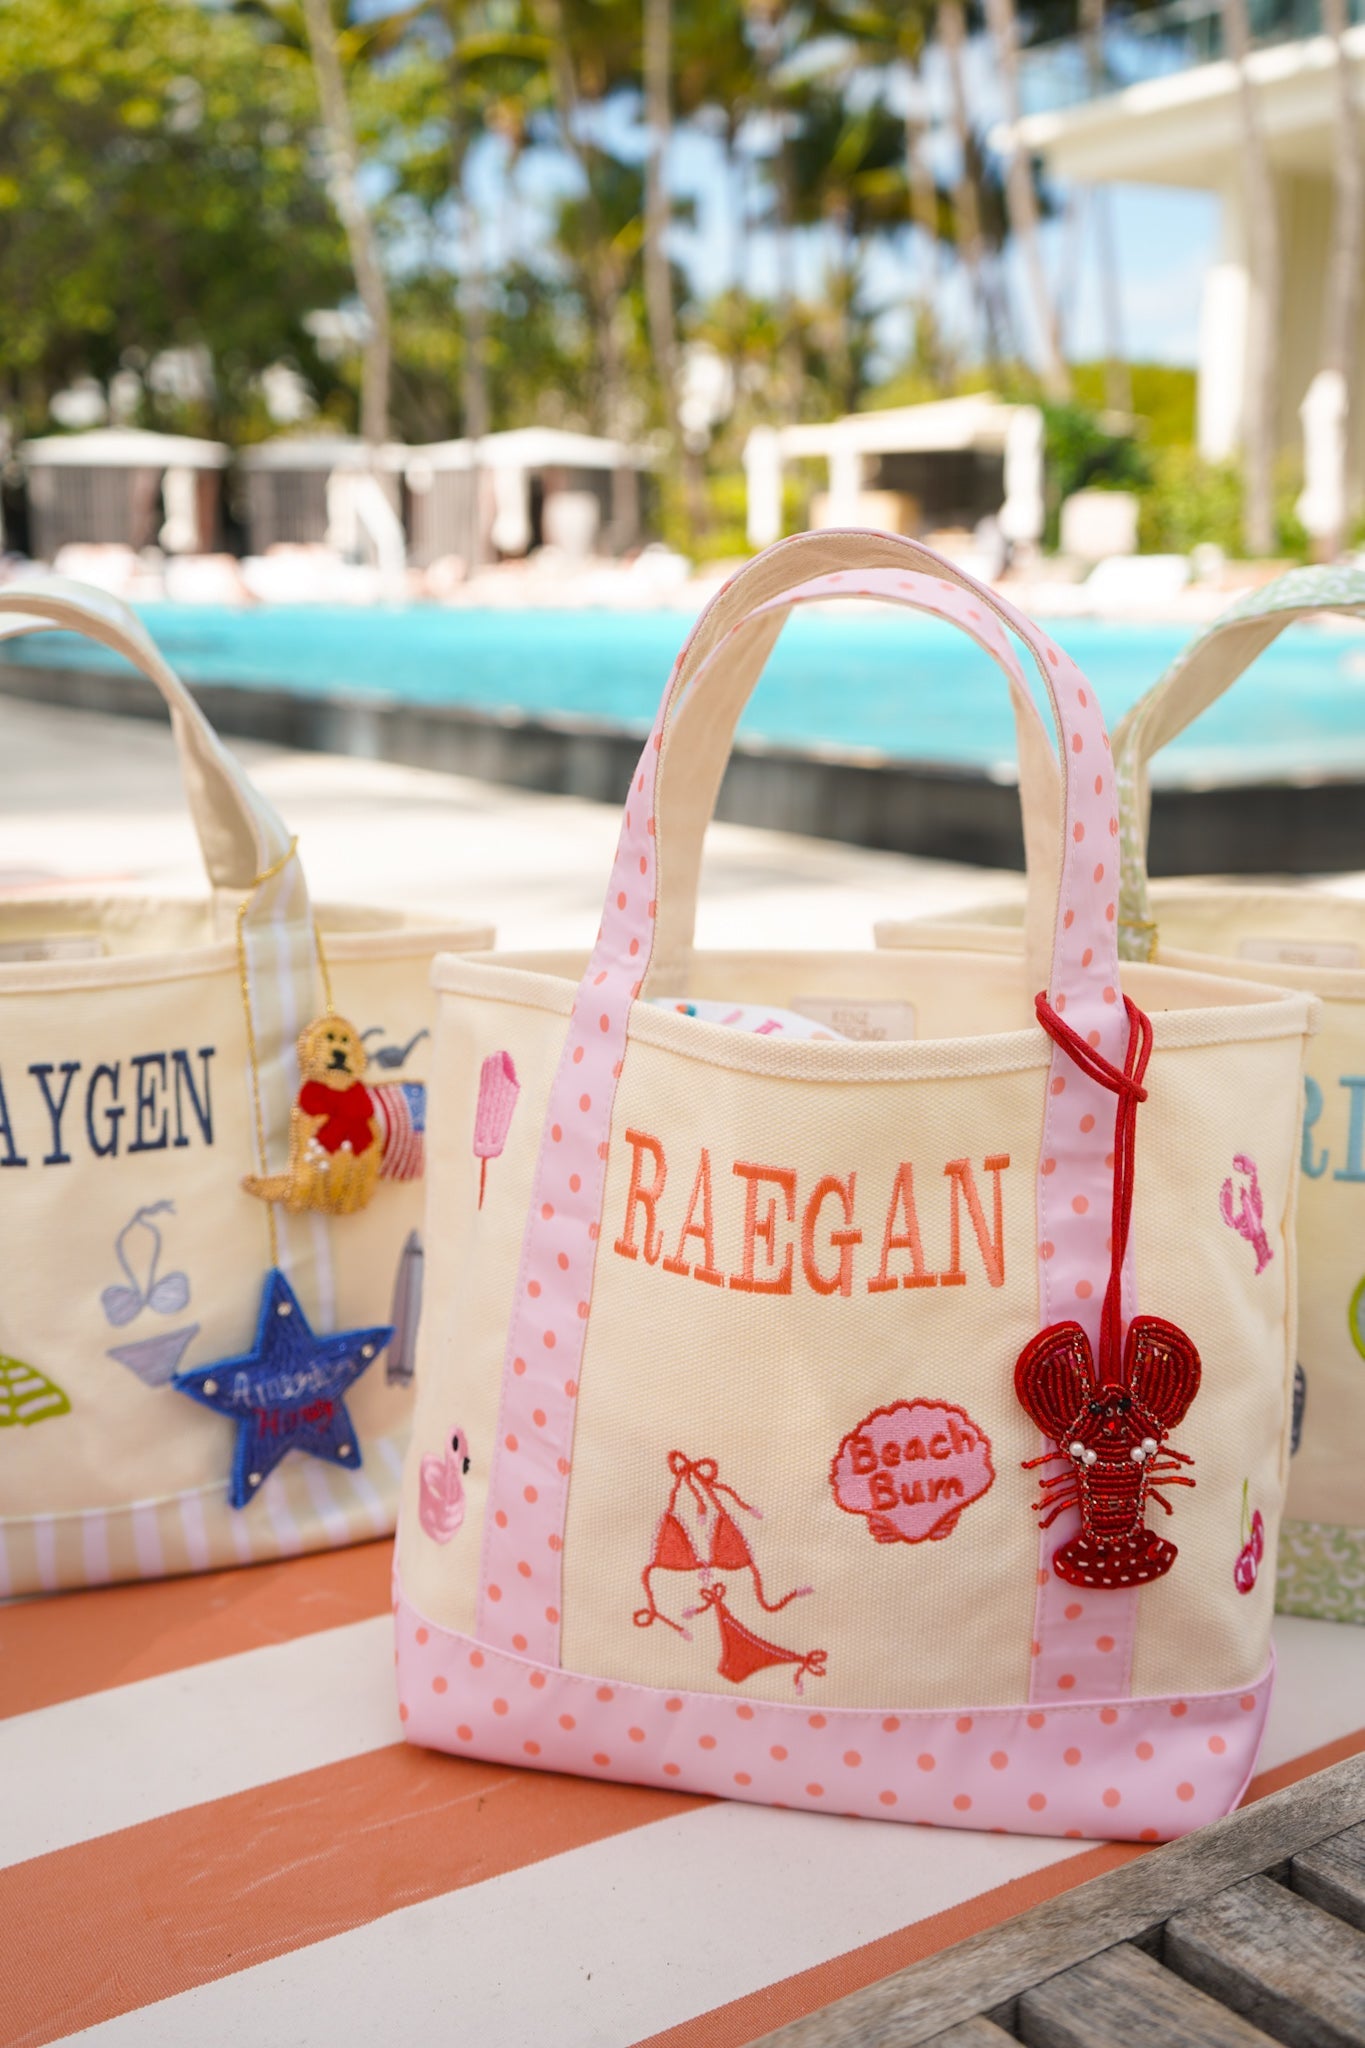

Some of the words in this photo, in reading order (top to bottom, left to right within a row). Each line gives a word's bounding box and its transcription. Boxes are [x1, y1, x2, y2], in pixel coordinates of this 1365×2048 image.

[614, 1127, 1010, 1297] RAEGAN
[848, 1418, 977, 1475] Beach
[869, 1470, 964, 1511] Bum
